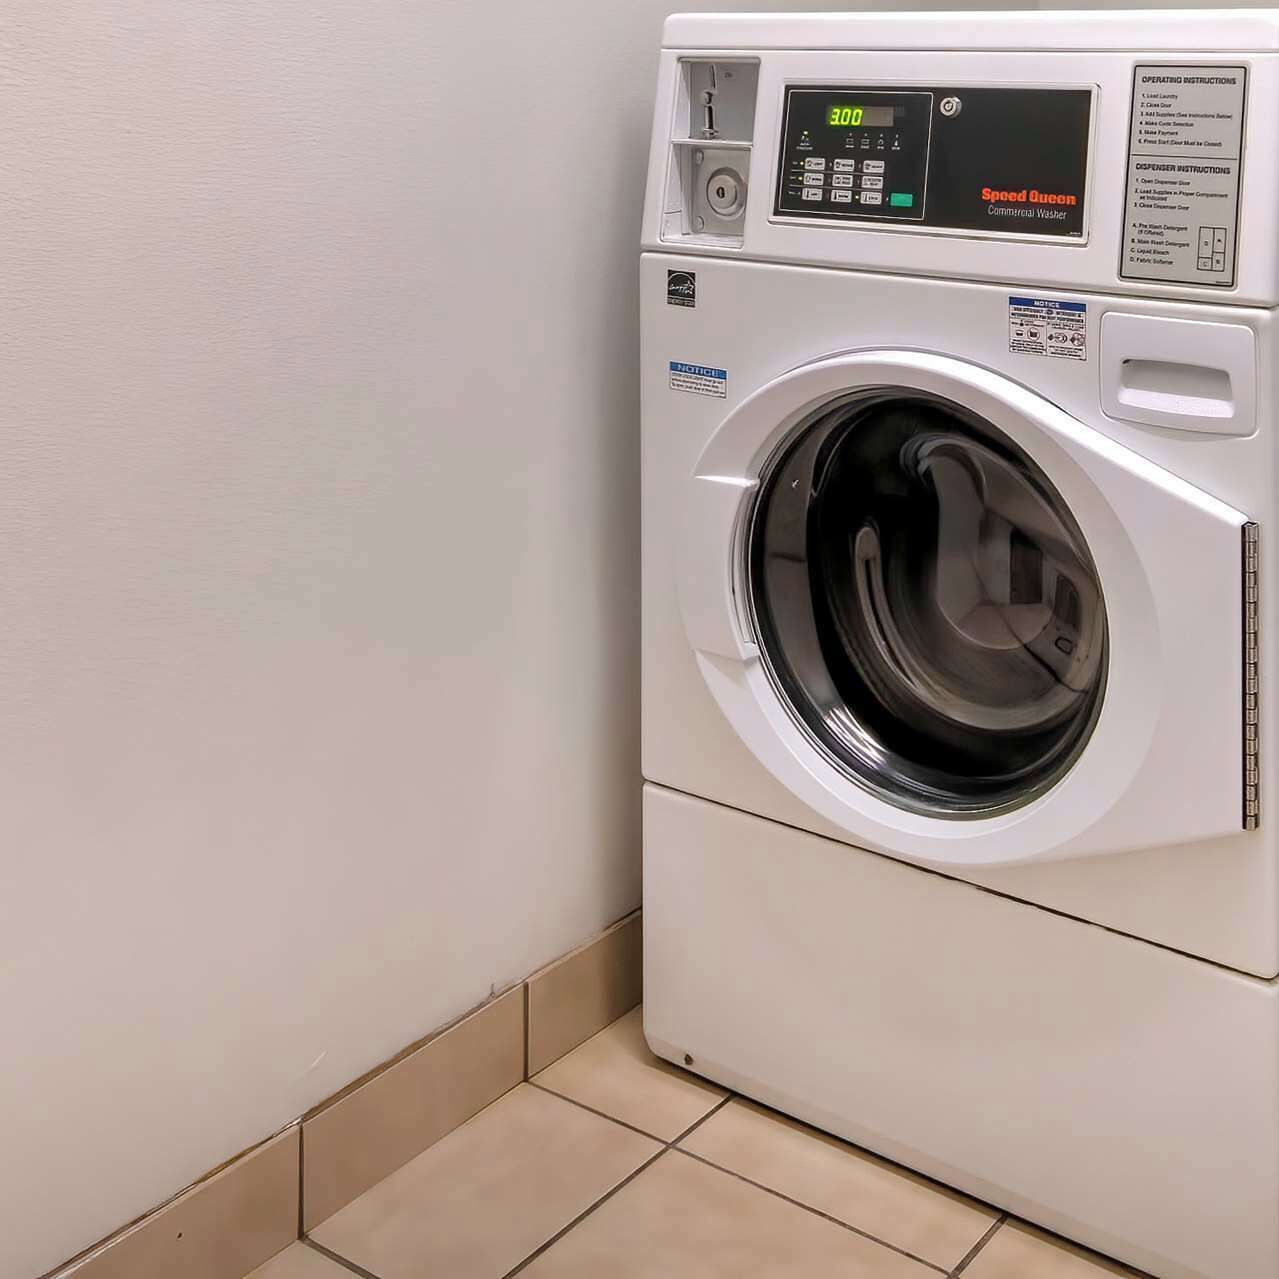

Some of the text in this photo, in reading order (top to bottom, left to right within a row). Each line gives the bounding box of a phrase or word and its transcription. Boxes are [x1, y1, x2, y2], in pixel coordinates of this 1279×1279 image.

[1141, 76, 1236, 85] OPERATING INSTRUCTIONS
[1135, 163, 1231, 175] DISPENSER INSTRUCTIONS
[982, 187, 1077, 205] Speed Queen
[988, 204, 1067, 220] Commercial Washer
[1033, 300, 1060, 308] NOTICE
[677, 364, 720, 378] NOTICE
